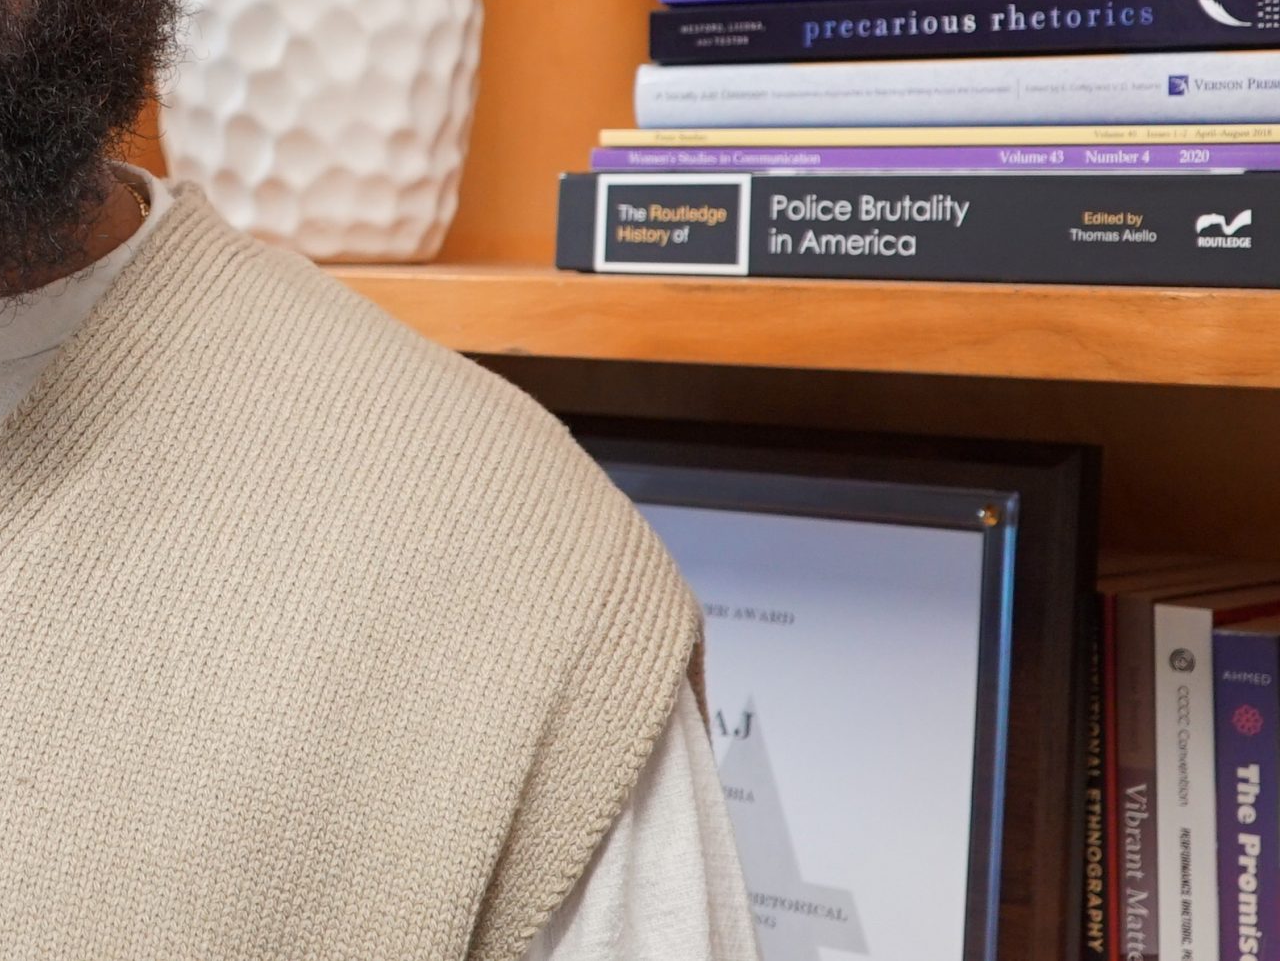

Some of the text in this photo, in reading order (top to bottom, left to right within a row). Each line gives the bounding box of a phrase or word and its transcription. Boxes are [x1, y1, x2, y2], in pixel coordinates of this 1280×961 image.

[803, 1, 1154, 47] precarious rhetorics
[1194, 78, 1243, 92] VERNON
[679, 150, 717, 164] Studies
[733, 150, 820, 165] Communication
[1000, 149, 1210, 164] Volume 43 Number 4 2020
[618, 204, 727, 226] The Routledge
[770, 194, 970, 227] Police Brutality
[1083, 211, 1144, 228] Edited by
[617, 225, 689, 247] History of
[770, 227, 916, 256] in America
[1070, 228, 1157, 242] Thomas Aiello
[1197, 236, 1252, 248] ROUTLEDGE
[733, 607, 796, 625] AWARD
[1223, 669, 1272, 686] AHMED
[1177, 685, 1191, 808] CCCC Convention
[1236, 764, 1261, 825] The
[1124, 783, 1150, 883] Vibrant
[1087, 789, 1104, 953] ETHNOGRAPHY
[1179, 827, 1193, 895] PERFORMANCE
